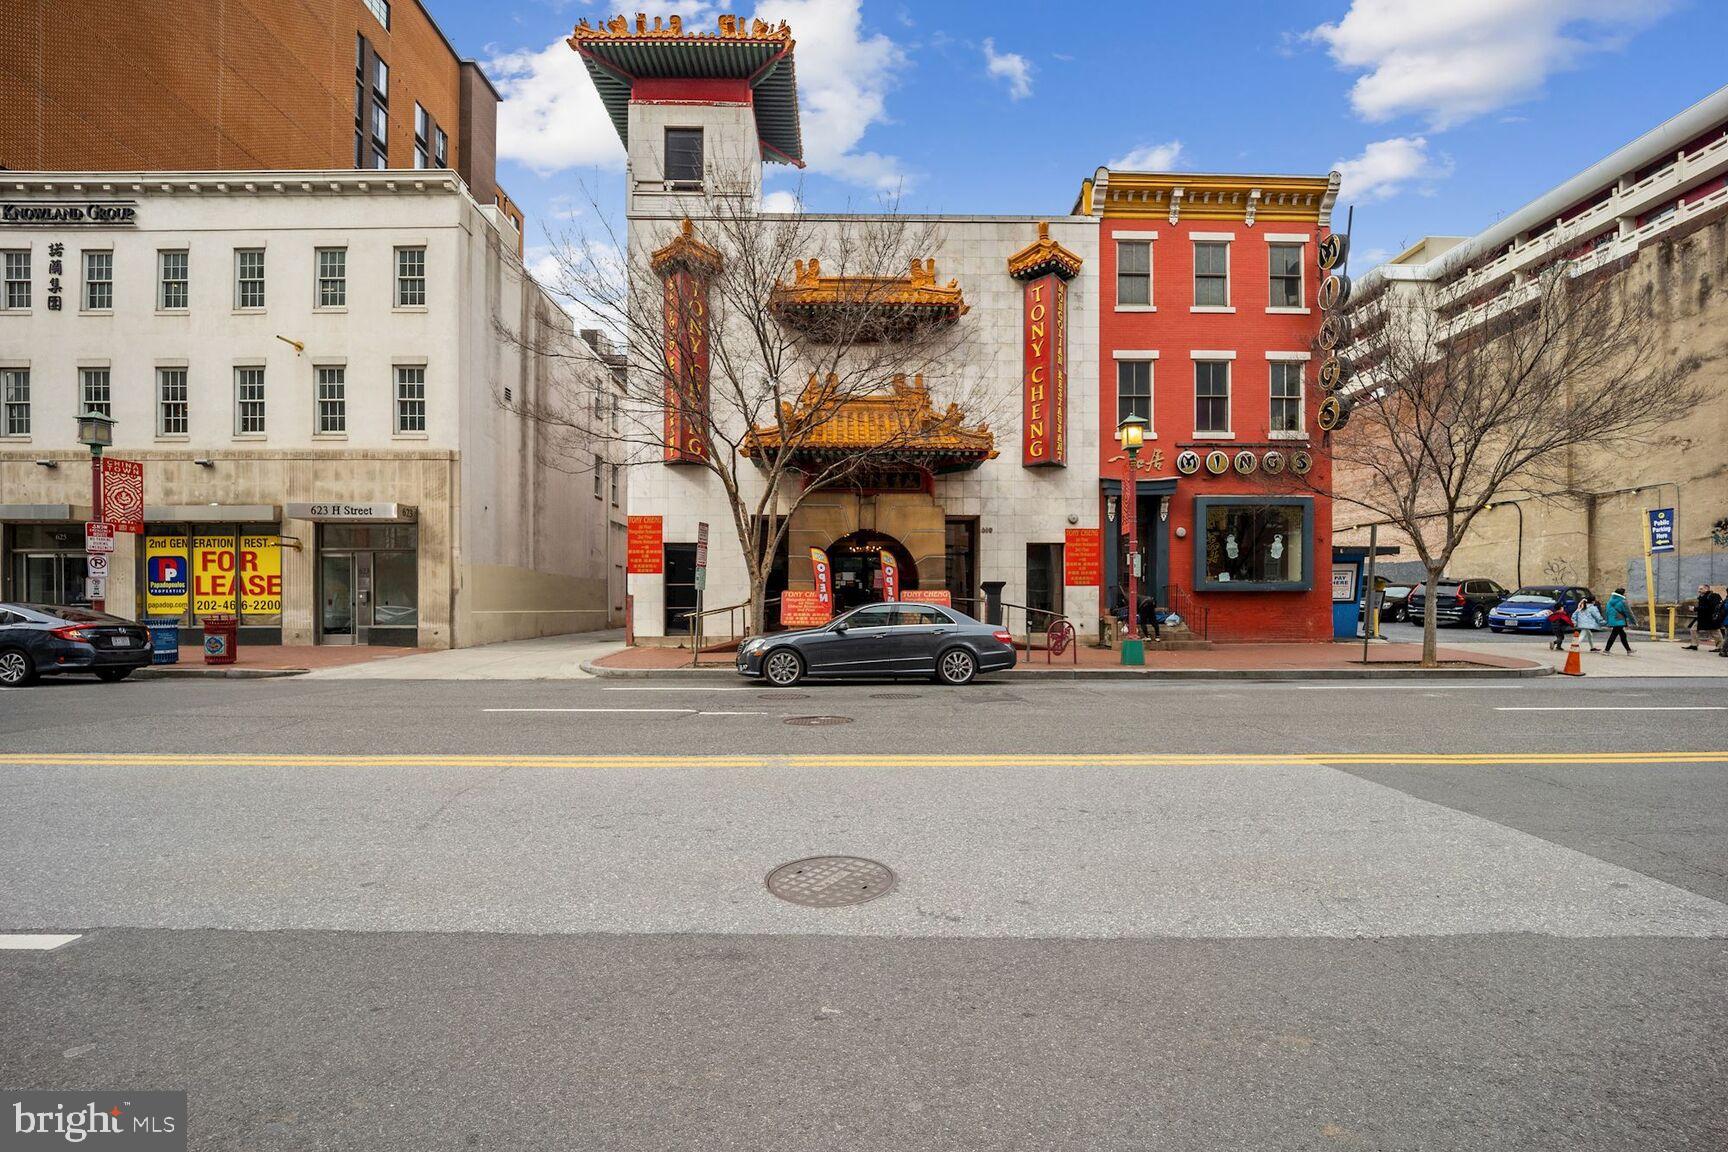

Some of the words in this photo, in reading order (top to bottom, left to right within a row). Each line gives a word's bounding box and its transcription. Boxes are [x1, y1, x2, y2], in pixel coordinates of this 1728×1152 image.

[1031, 284, 1045, 357] TONY
[1029, 366, 1044, 457] CHENG
[106, 460, 139, 470] CHINA
[1179, 453, 1310, 472] MINGS
[107, 466, 139, 475] TOWN
[310, 506, 328, 515] 623
[332, 506, 341, 515] H
[344, 506, 373, 515] Street
[149, 539, 166, 548] 2nd
[170, 538, 233, 548] GENERATION
[244, 538, 271, 548] REST.
[201, 550, 258, 572] FOR
[195, 575, 282, 596] LEASE
[197, 600, 281, 611] 202-466-2200
